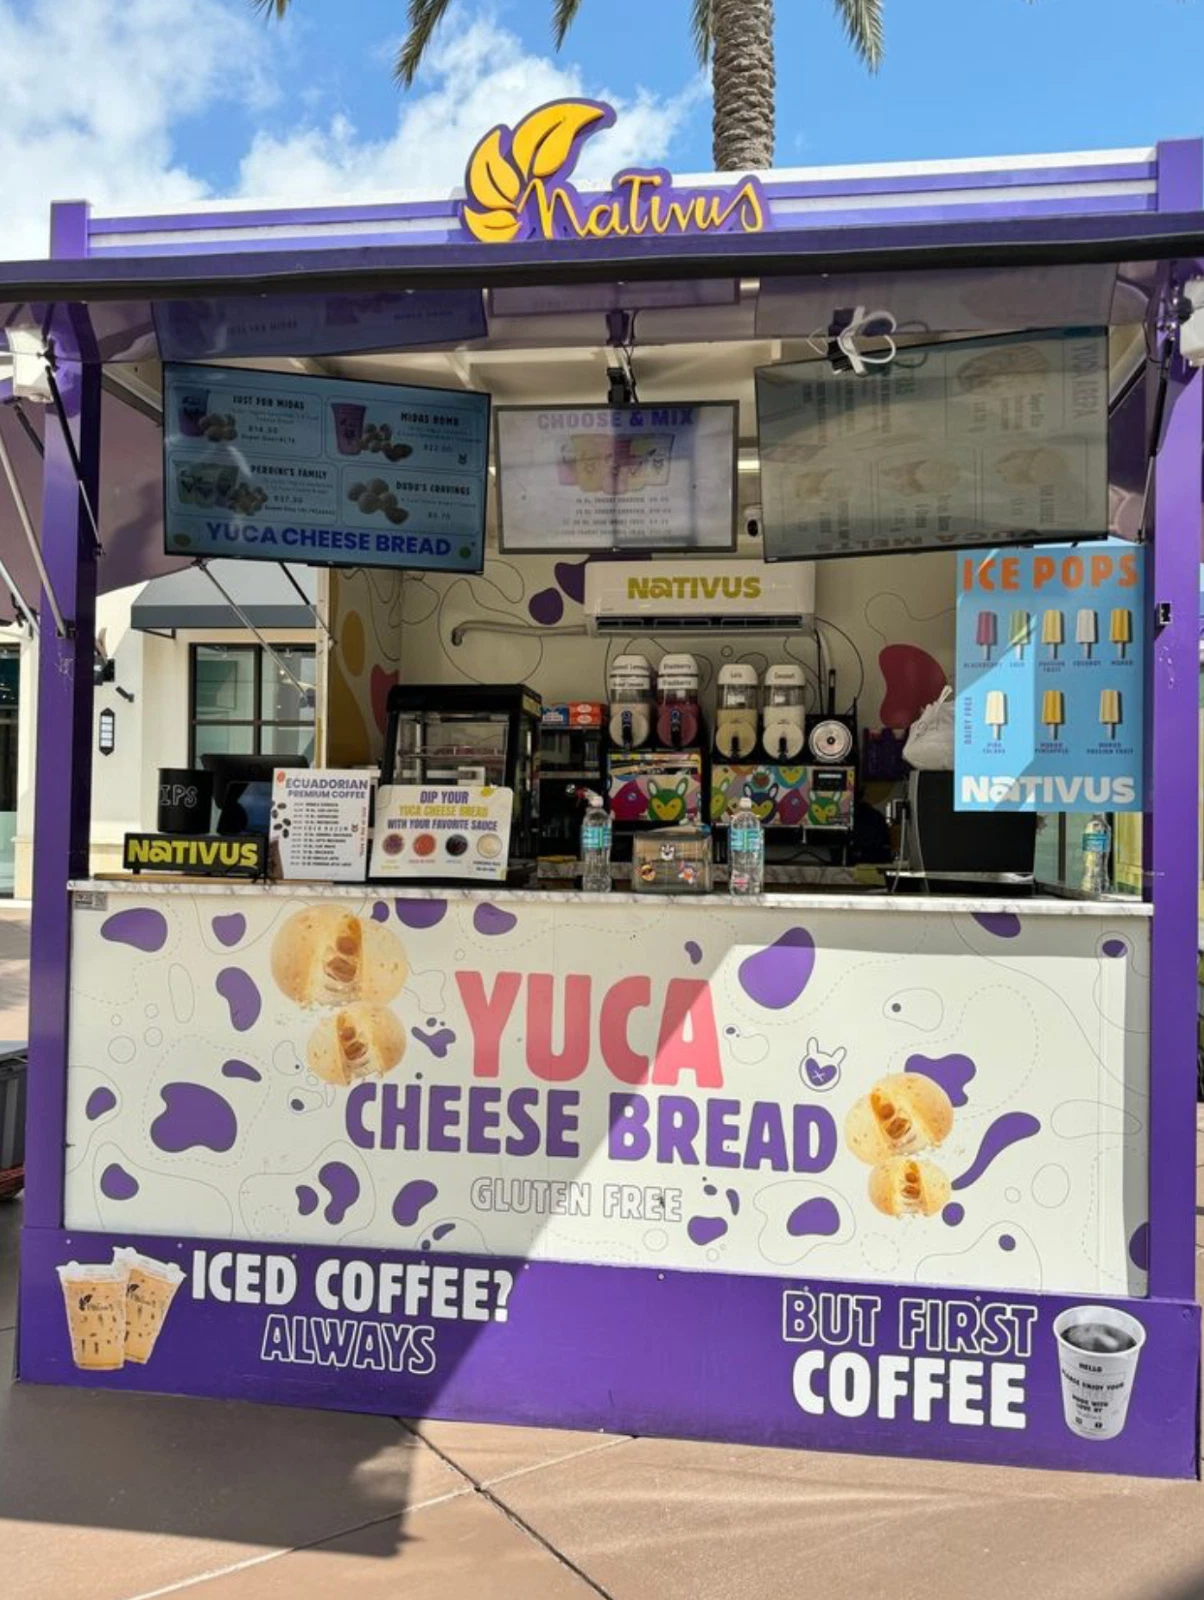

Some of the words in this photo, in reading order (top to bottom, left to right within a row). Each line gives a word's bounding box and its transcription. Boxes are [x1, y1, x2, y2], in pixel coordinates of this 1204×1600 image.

[256, 397, 273, 407] FOR
[277, 399, 305, 410] MIDAS
[401, 412, 429, 423] MIDAS
[537, 409, 622, 430] CHOOSE
[629, 409, 645, 427] &
[651, 407, 694, 426] MIX
[298, 468, 327, 479] FAMILY
[430, 484, 471, 495] CRAVINGS
[206, 521, 278, 545] YUCA
[281, 527, 371, 551] CHEESE
[375, 534, 451, 556] BREAD
[962, 556, 1020, 592] ICE
[1033, 553, 1139, 589] POPS
[285, 777, 369, 790] ECUADORIAN
[288, 790, 330, 798] PREMIUM
[331, 791, 366, 799] COFFEE
[420, 790, 438, 804] DIP
[441, 791, 469, 804] YOUR
[400, 805, 422, 816] YUCA
[423, 805, 457, 817] CHEESE
[458, 806, 488, 817] BREAD
[387, 819, 407, 829] WITH
[409, 819, 430, 829] YOUR
[432, 819, 470, 830] FAVORITE
[471, 820, 498, 831] SAUCE
[455, 970, 725, 1089] YUCA
[345, 1081, 581, 1158] CHEESE
[607, 1091, 838, 1174] BREAD
[470, 1176, 592, 1218] GLUTEN
[602, 1183, 683, 1223] FREE
[191, 1250, 298, 1306] ICED
[315, 1258, 515, 1323] COFFEE?
[781, 1290, 882, 1347] BUT
[898, 1298, 1038, 1358] FIRST
[260, 1313, 437, 1375] ALWAYS
[1079, 1362, 1102, 1373] HELLO
[792, 1349, 1027, 1430] COFFEE
[1082, 1381, 1104, 1391] ENJOY
[1106, 1381, 1125, 1391] YOUR
